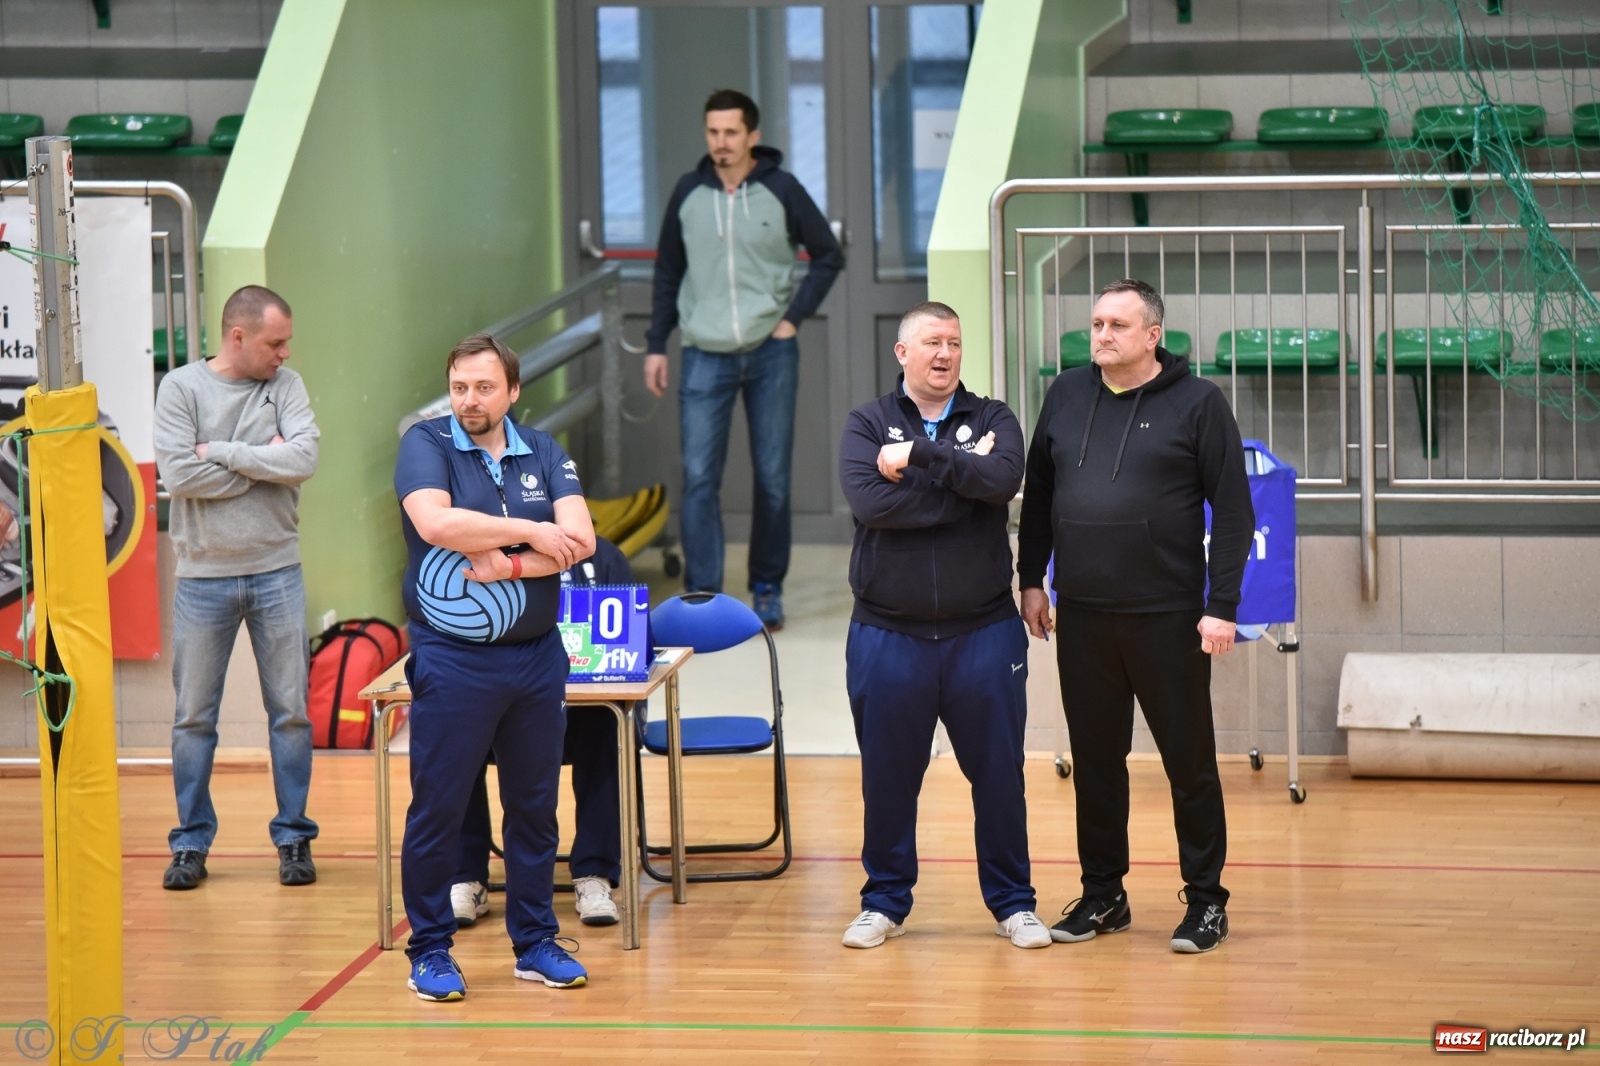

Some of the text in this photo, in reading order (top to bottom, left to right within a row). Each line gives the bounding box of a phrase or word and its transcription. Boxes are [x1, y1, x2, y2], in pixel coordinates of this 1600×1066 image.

[0, 305, 9, 329] i
[0, 339, 37, 359] kła
[599, 597, 623, 639] 0
